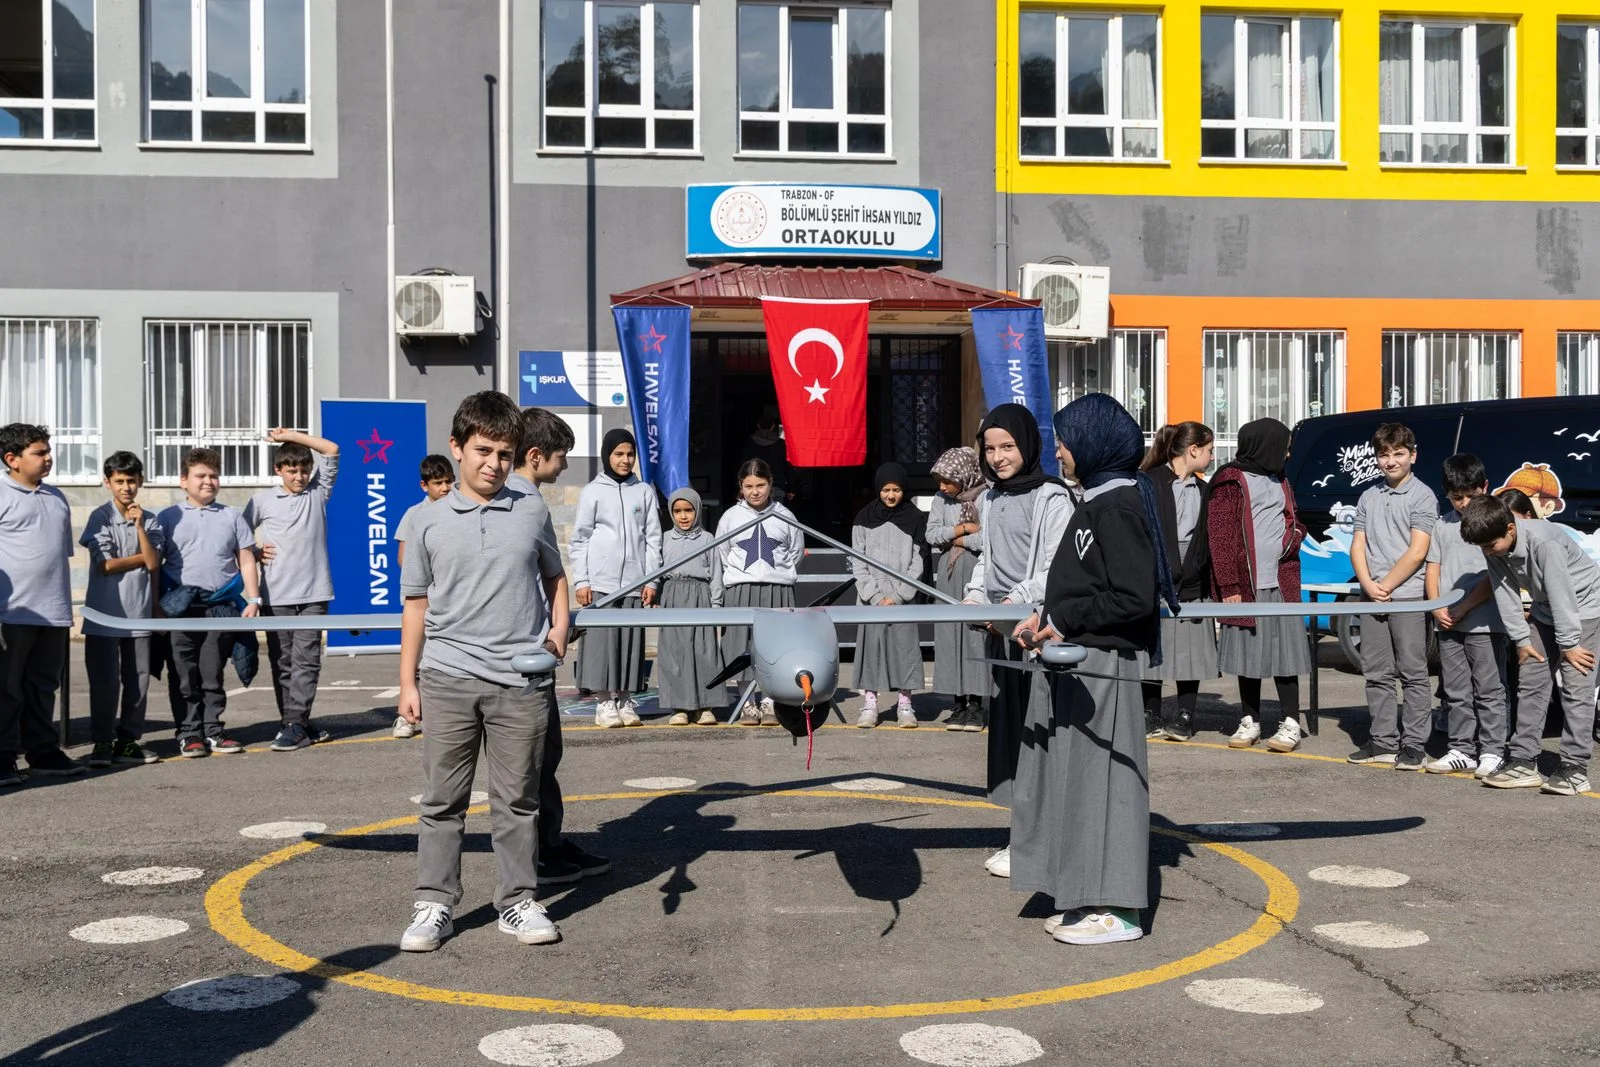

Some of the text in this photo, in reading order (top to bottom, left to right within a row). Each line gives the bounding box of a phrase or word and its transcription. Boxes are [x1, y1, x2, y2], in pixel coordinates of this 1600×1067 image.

[781, 190, 817, 200] TRABZON
[824, 190, 834, 200] OF
[781, 203, 829, 221] BÖLÜMLÜ
[831, 204, 860, 223] ŞEHİT
[862, 205, 891, 224] İHSAN
[893, 210, 922, 226] YILDIZ
[781, 228, 895, 246] ORTAOKULU
[1007, 359, 1027, 406] HAVE
[645, 362, 659, 464] HAVELSAN
[1343, 441, 1375, 463] Müh
[1354, 456, 1379, 472] Çoc
[1350, 465, 1384, 487] Yolla
[367, 473, 389, 606] HAVELSAN
